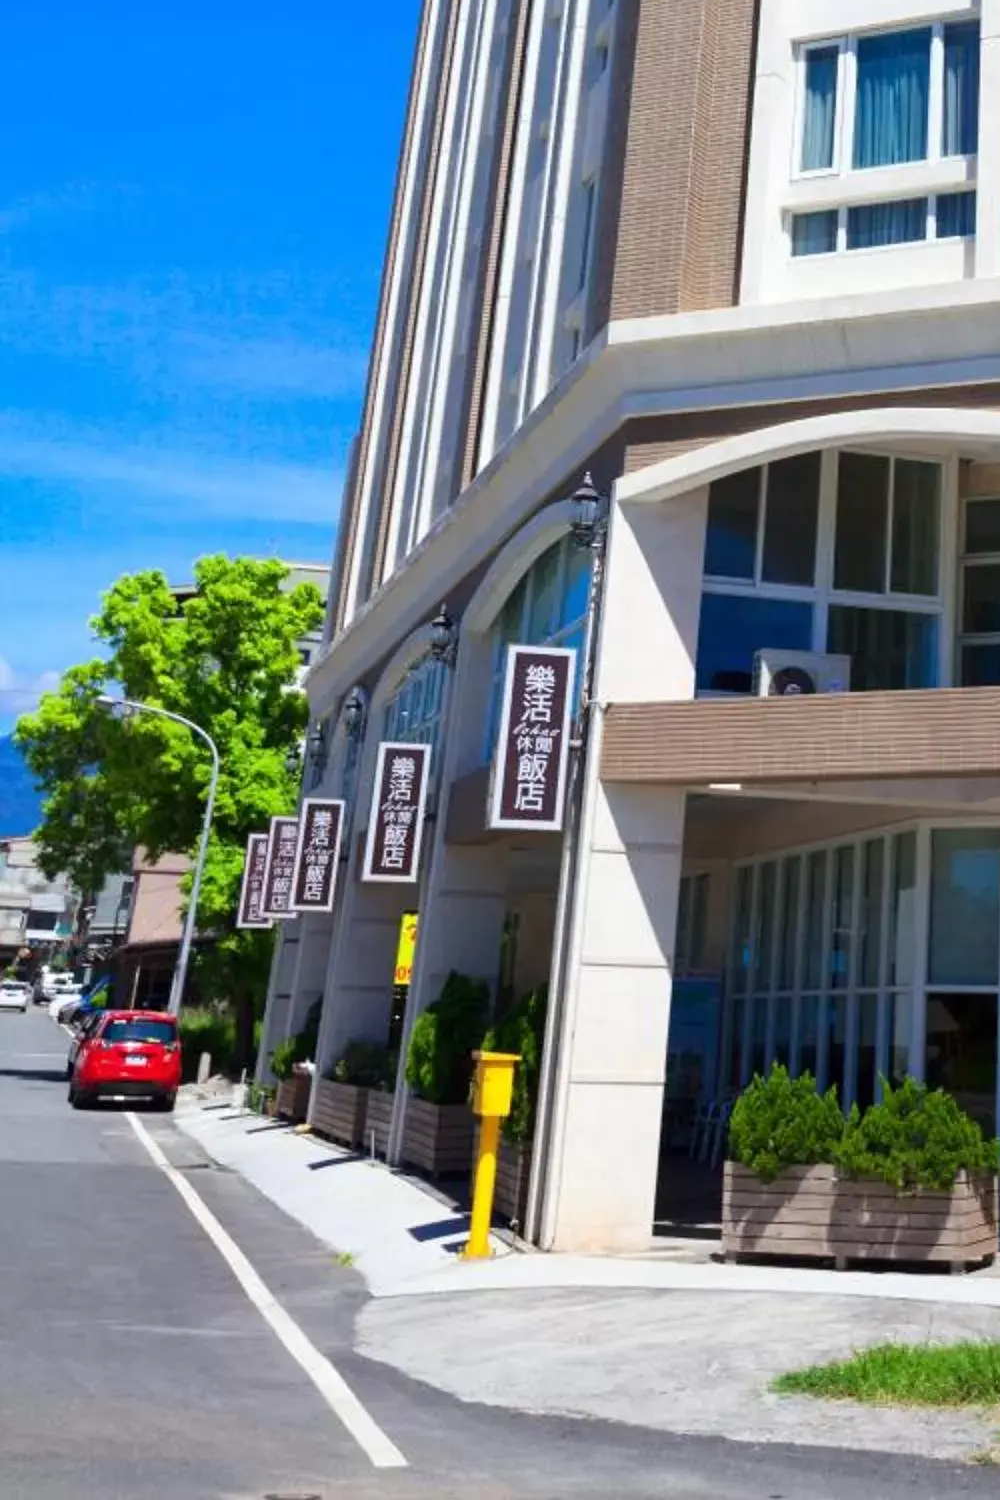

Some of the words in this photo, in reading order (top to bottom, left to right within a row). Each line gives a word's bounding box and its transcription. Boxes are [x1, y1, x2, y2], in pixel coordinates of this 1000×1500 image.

[521, 664, 556, 722] 樂活
[514, 753, 549, 812] 飯店
[381, 825, 409, 868] 飯店
